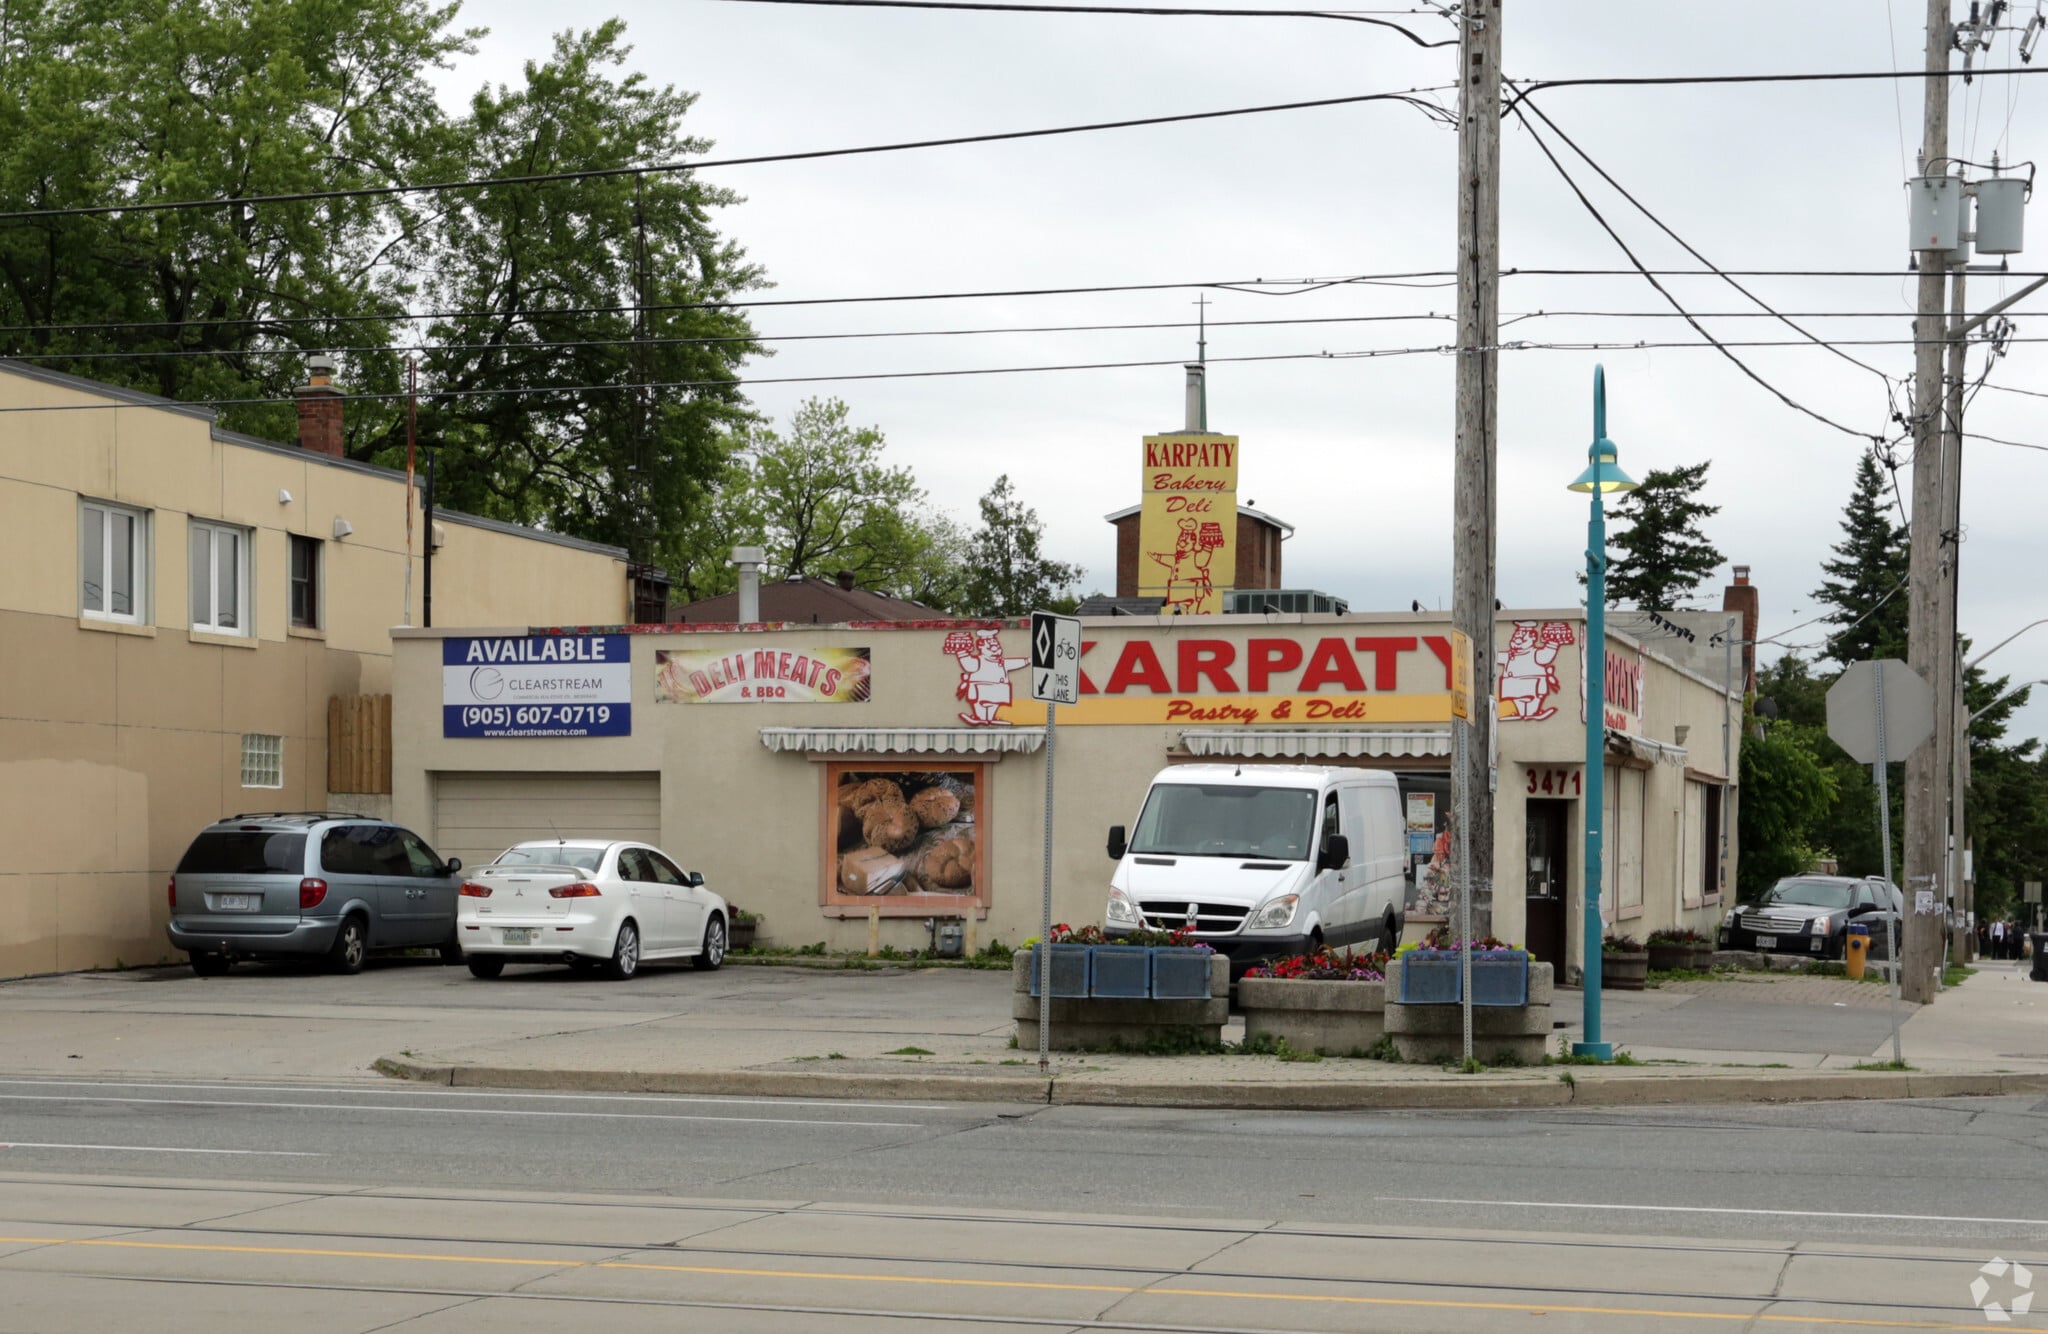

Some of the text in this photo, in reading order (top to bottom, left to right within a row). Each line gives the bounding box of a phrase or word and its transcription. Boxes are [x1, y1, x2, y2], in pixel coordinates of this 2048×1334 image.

[1146, 443, 1235, 467] KARPATY
[1152, 473, 1226, 494] Bakery
[1165, 495, 1213, 513] Deli
[466, 637, 606, 662] AVAILABLE
[509, 678, 603, 691] CLEARSTREAM
[689, 651, 842, 698] DELI MEATS
[1055, 673, 1069, 687] THIS
[1604, 649, 1638, 716] RPATY
[741, 686, 786, 698] & BBQ
[462, 705, 611, 727] (905) 607-0719
[1166, 699, 1366, 724] Pastry & Deli
[484, 727, 588, 737] www.clearstreamcre.com
[1526, 769, 1581, 796] 3471
